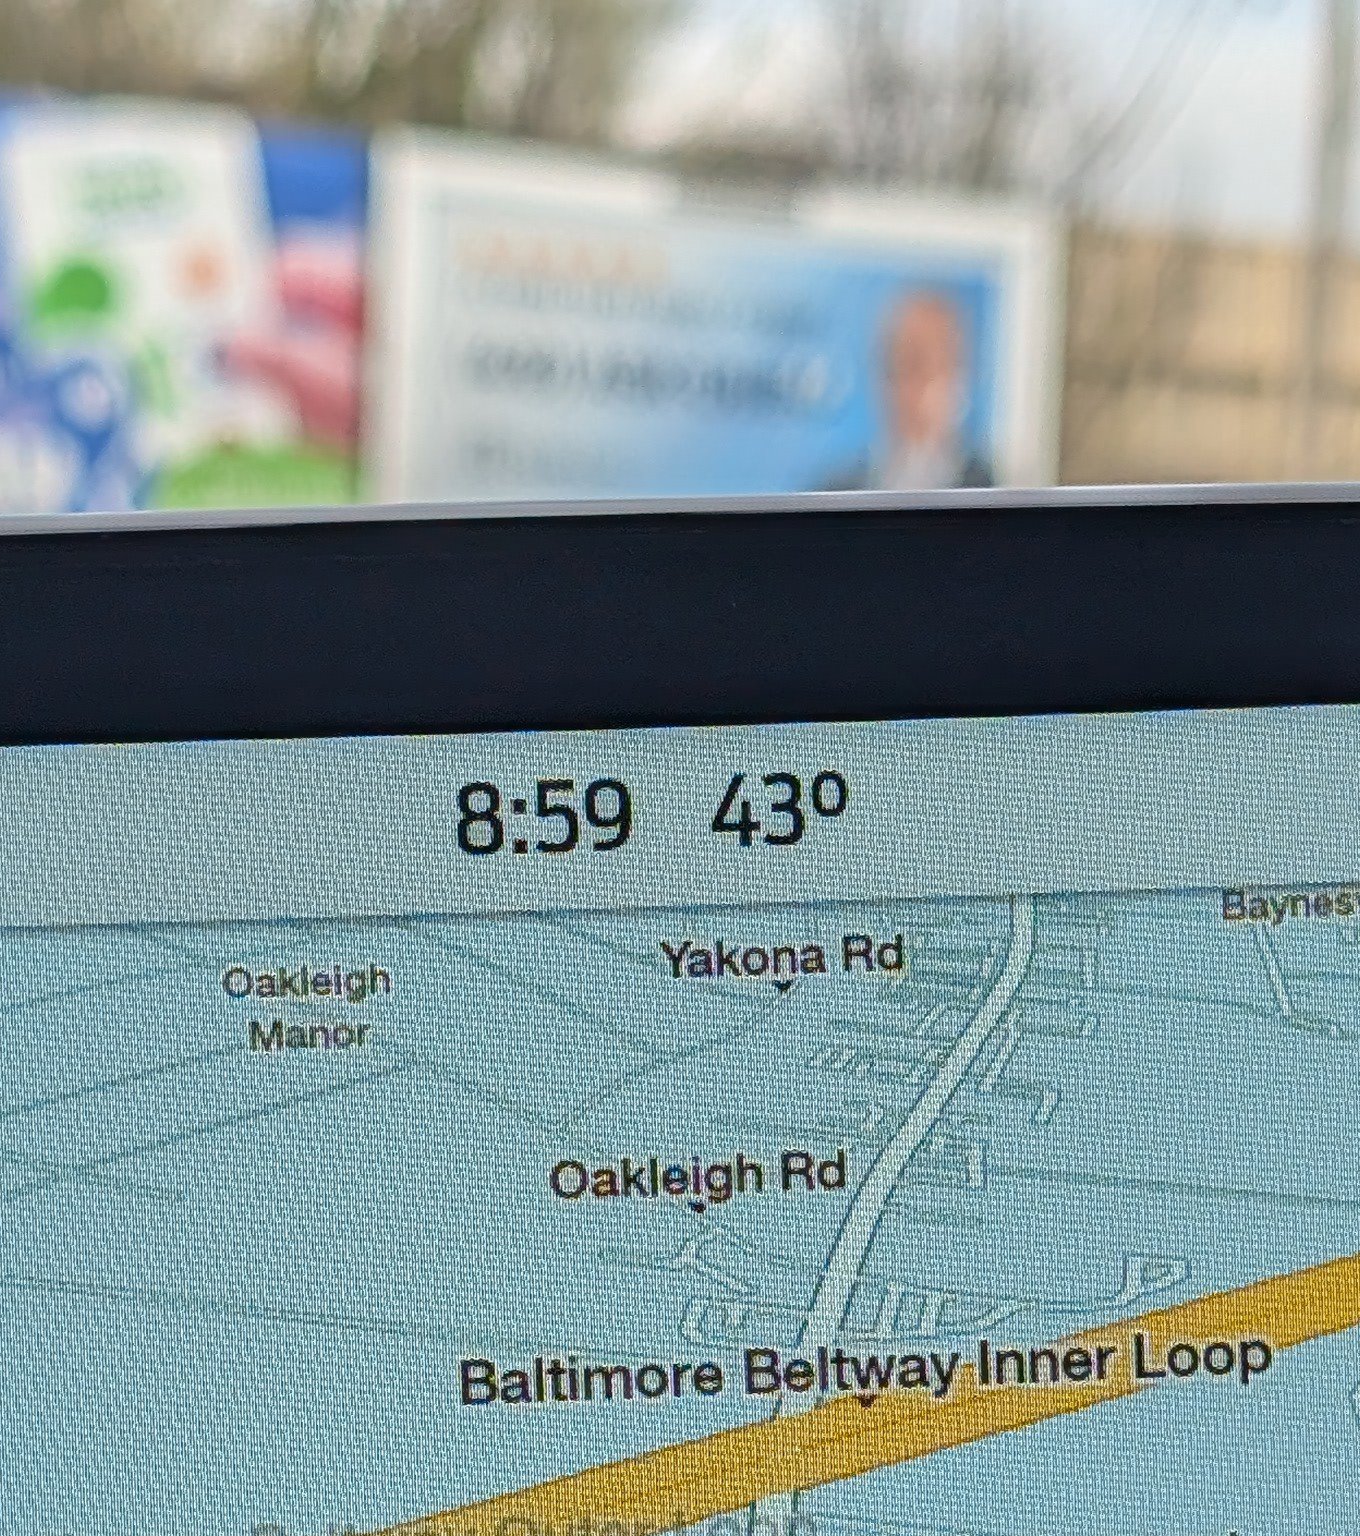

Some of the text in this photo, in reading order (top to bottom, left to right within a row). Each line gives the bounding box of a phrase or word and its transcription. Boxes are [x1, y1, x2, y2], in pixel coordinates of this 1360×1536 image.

[456, 779, 632, 855] 8:59
[660, 934, 904, 979] Yakona Rd
[222, 965, 391, 1001] Oakleigh
[248, 1019, 371, 1051] Manor
[549, 1149, 846, 1203] Oakleigh Rd
[460, 1331, 1272, 1406] Baltimore Beltway Inner Loop
